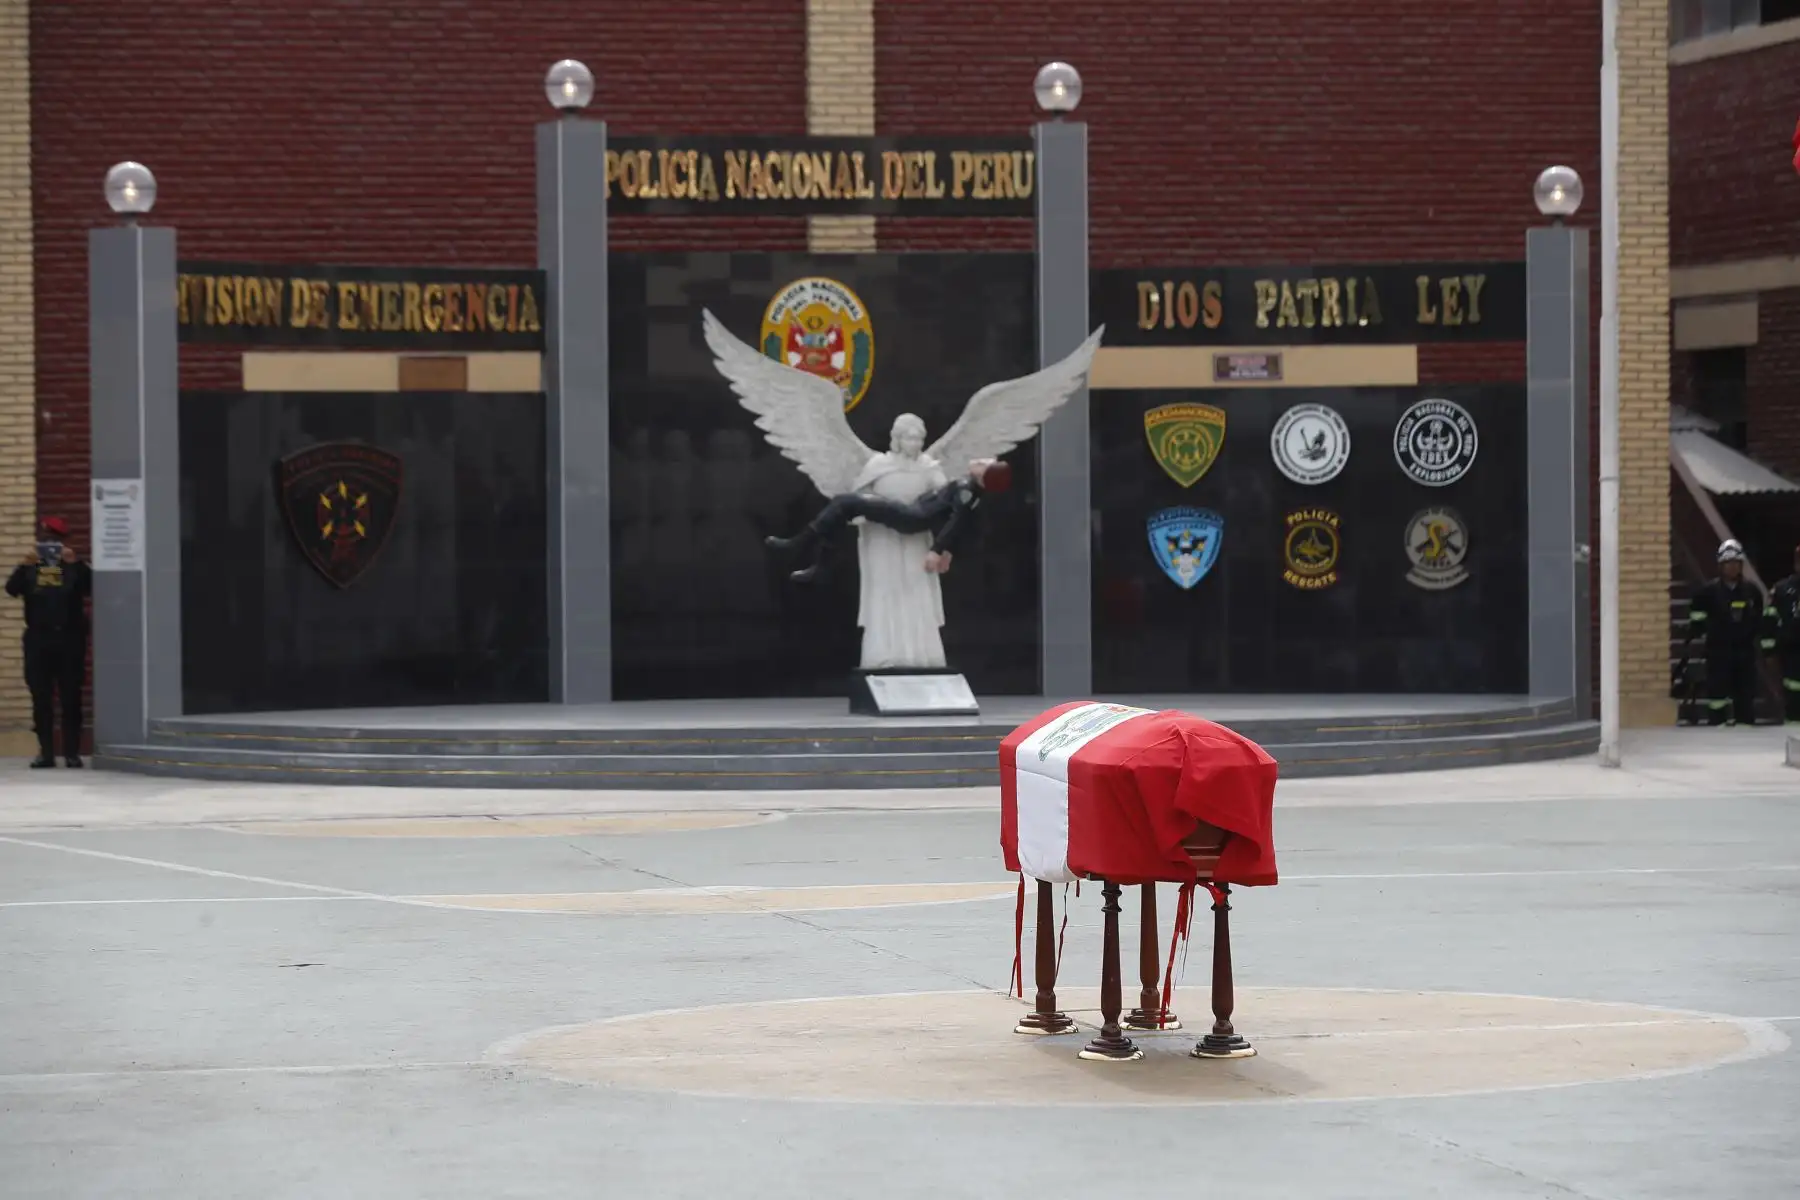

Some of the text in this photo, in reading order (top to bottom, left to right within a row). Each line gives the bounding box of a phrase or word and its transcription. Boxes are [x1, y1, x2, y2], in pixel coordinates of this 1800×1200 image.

[604, 149, 1035, 202] POLICIA NACIONAL DEL PERU
[177, 273, 542, 333] IVISION DE EMERGENCIA
[1136, 273, 1487, 330] DIOS PATRIA LEY
[1286, 508, 1340, 529] POLICIA
[1283, 568, 1337, 590] RESCATE
